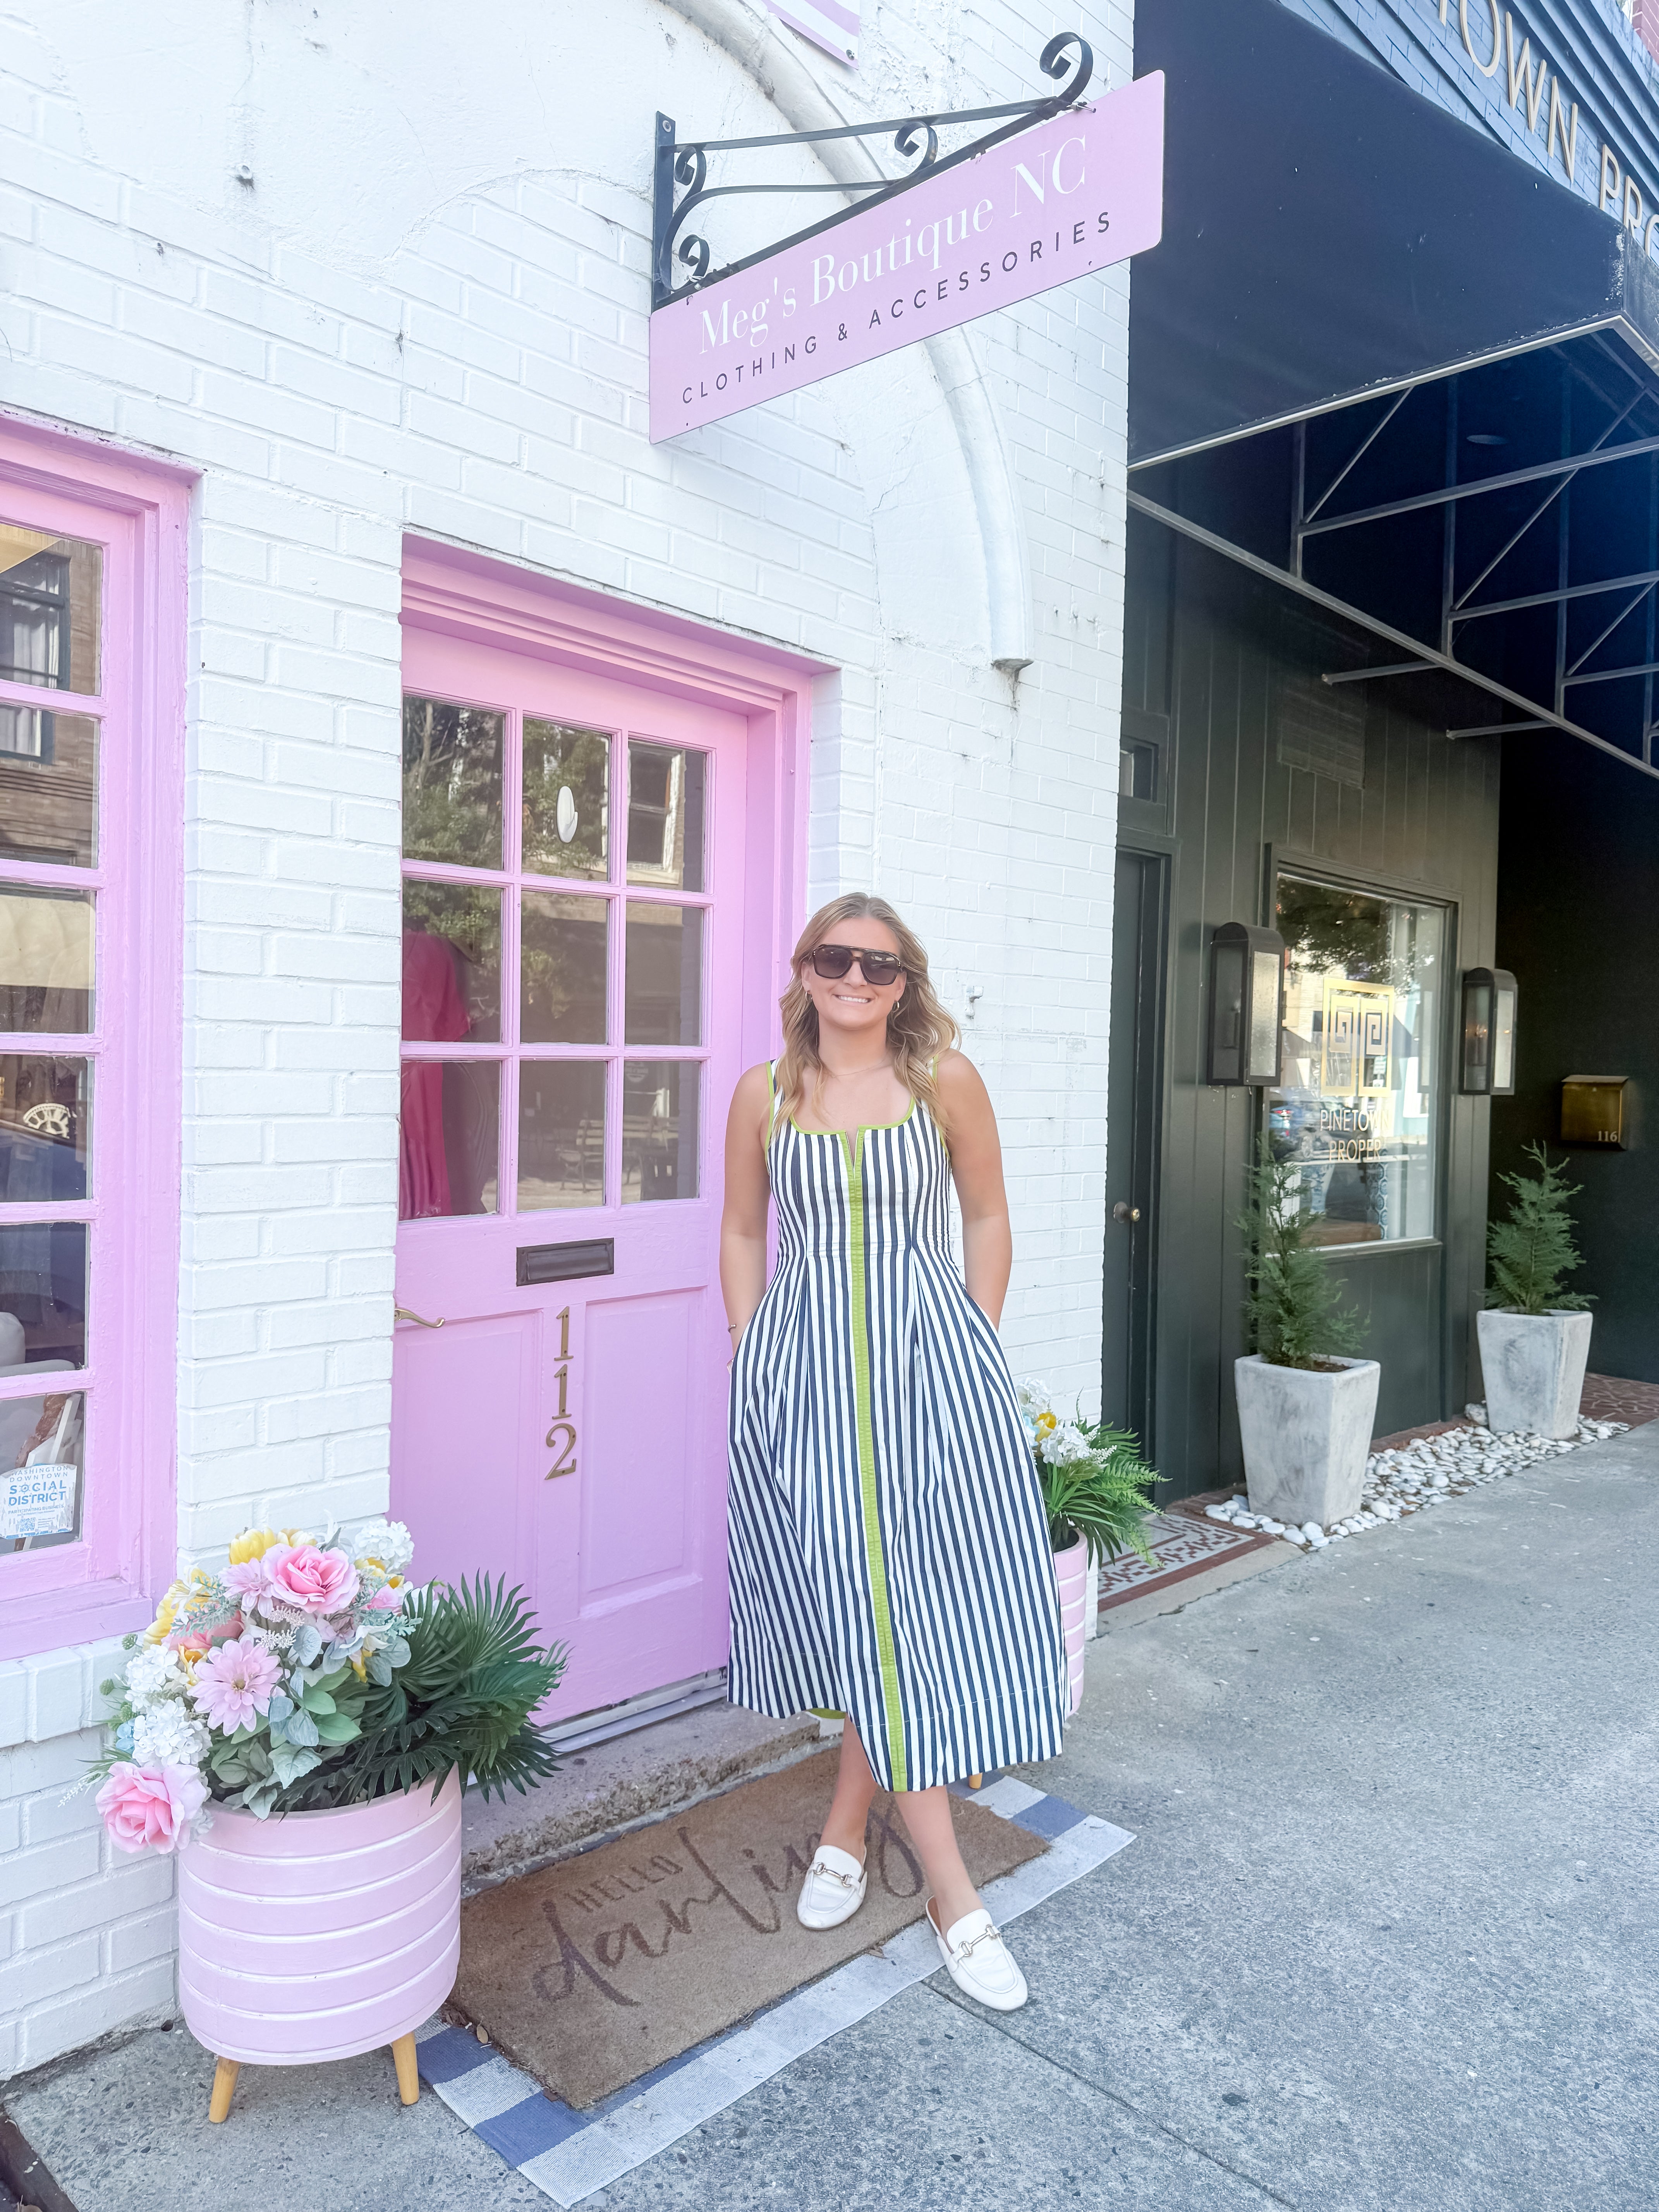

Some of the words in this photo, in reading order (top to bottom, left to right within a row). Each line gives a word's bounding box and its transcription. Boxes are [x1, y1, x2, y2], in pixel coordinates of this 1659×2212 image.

[1439, 0, 1578, 185] OWN
[699, 276, 796, 354] Meg's
[810, 199, 993, 306] Boutique
[1009, 134, 1085, 218] NC
[682, 336, 816, 404] CLOTHING
[838, 323, 848, 341] &
[869, 211, 1109, 329] ACCESSORIES
[1320, 1109, 1390, 1132] PINETOWN
[1597, 1130, 1618, 1142] 116
[1329, 1139, 1381, 1162] PROPER
[544, 1306, 577, 1480] 112
[10, 1472, 68, 1482] DOWNTOWN
[12, 1465, 68, 1476] WASHINGTON
[9, 1480, 67, 1494] SOCIAL
[9, 1491, 66, 1506] DISTRICT
[565, 1855, 683, 1913] HELLO
